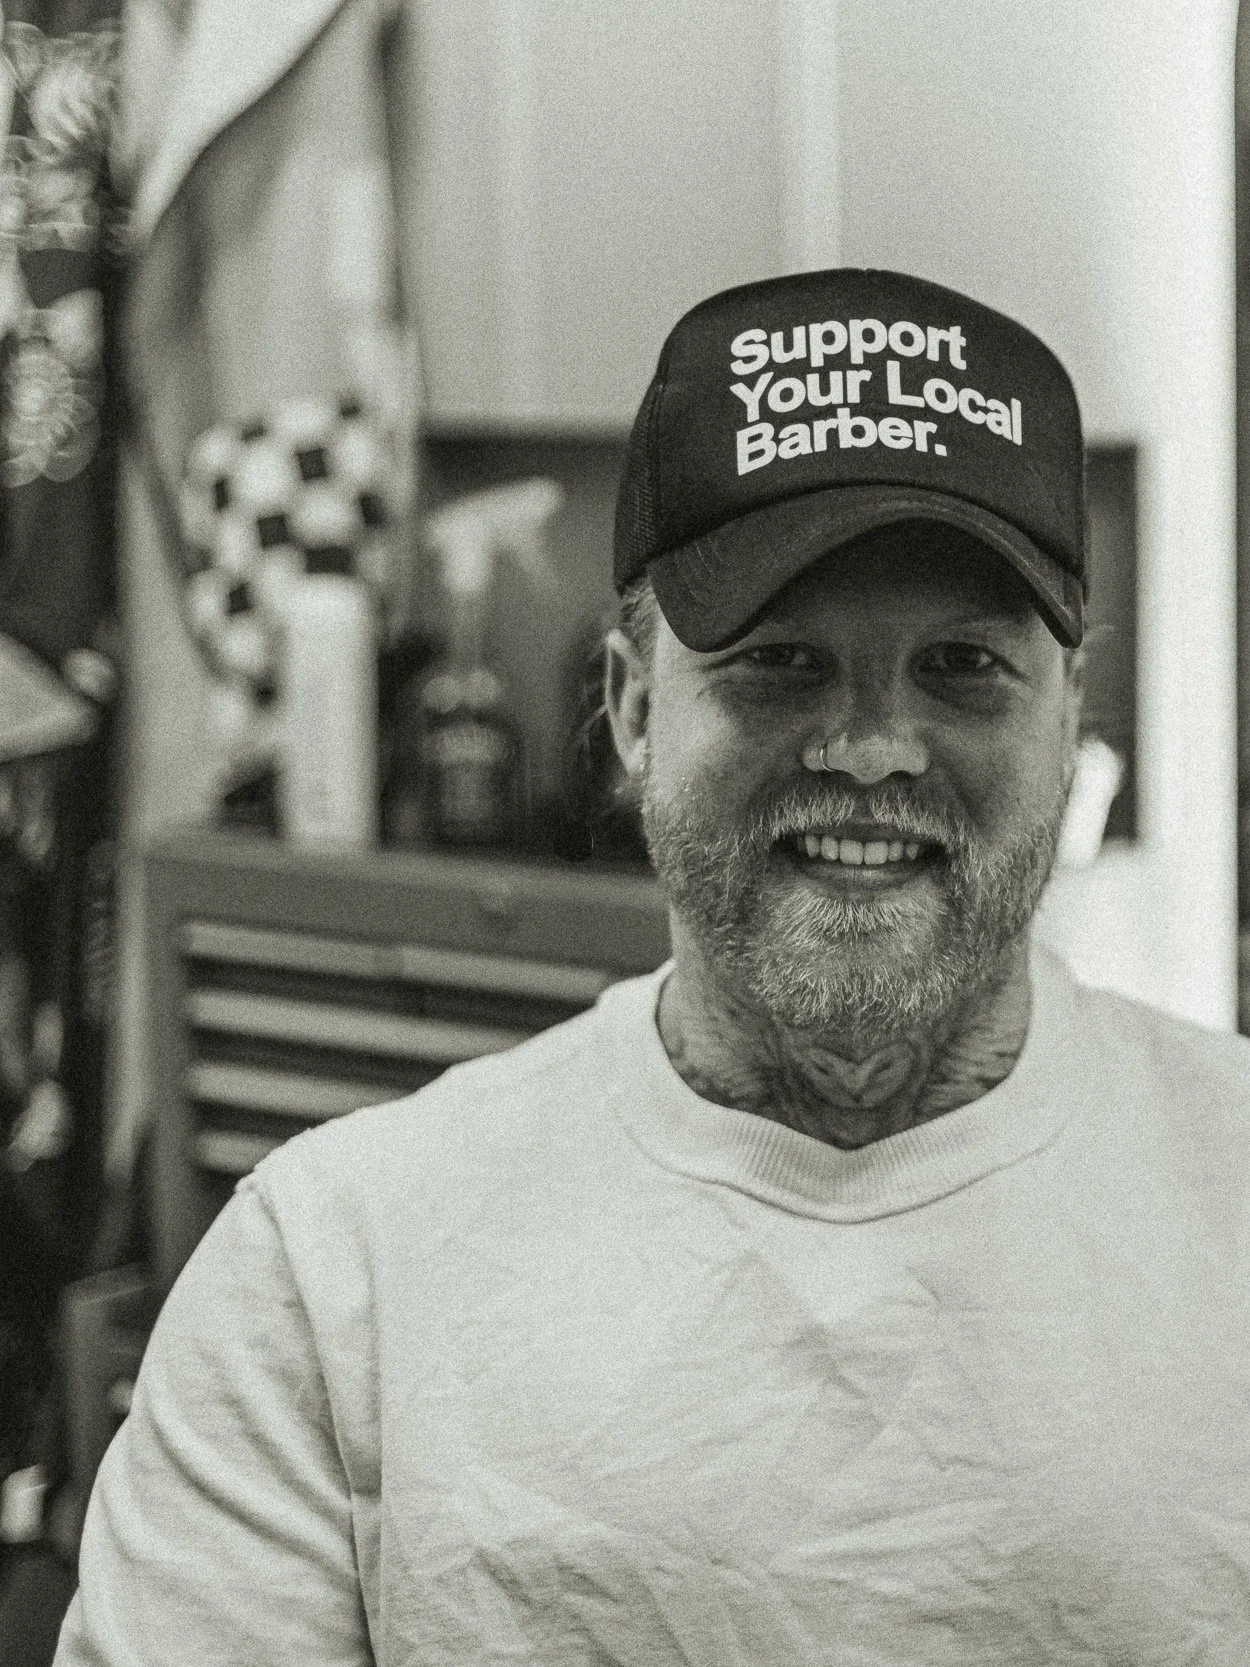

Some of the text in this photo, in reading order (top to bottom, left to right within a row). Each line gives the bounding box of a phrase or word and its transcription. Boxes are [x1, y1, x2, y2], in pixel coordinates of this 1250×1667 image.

[730, 318, 967, 376] Support
[729, 359, 1023, 446] Your Local
[736, 407, 948, 476] Barber.
